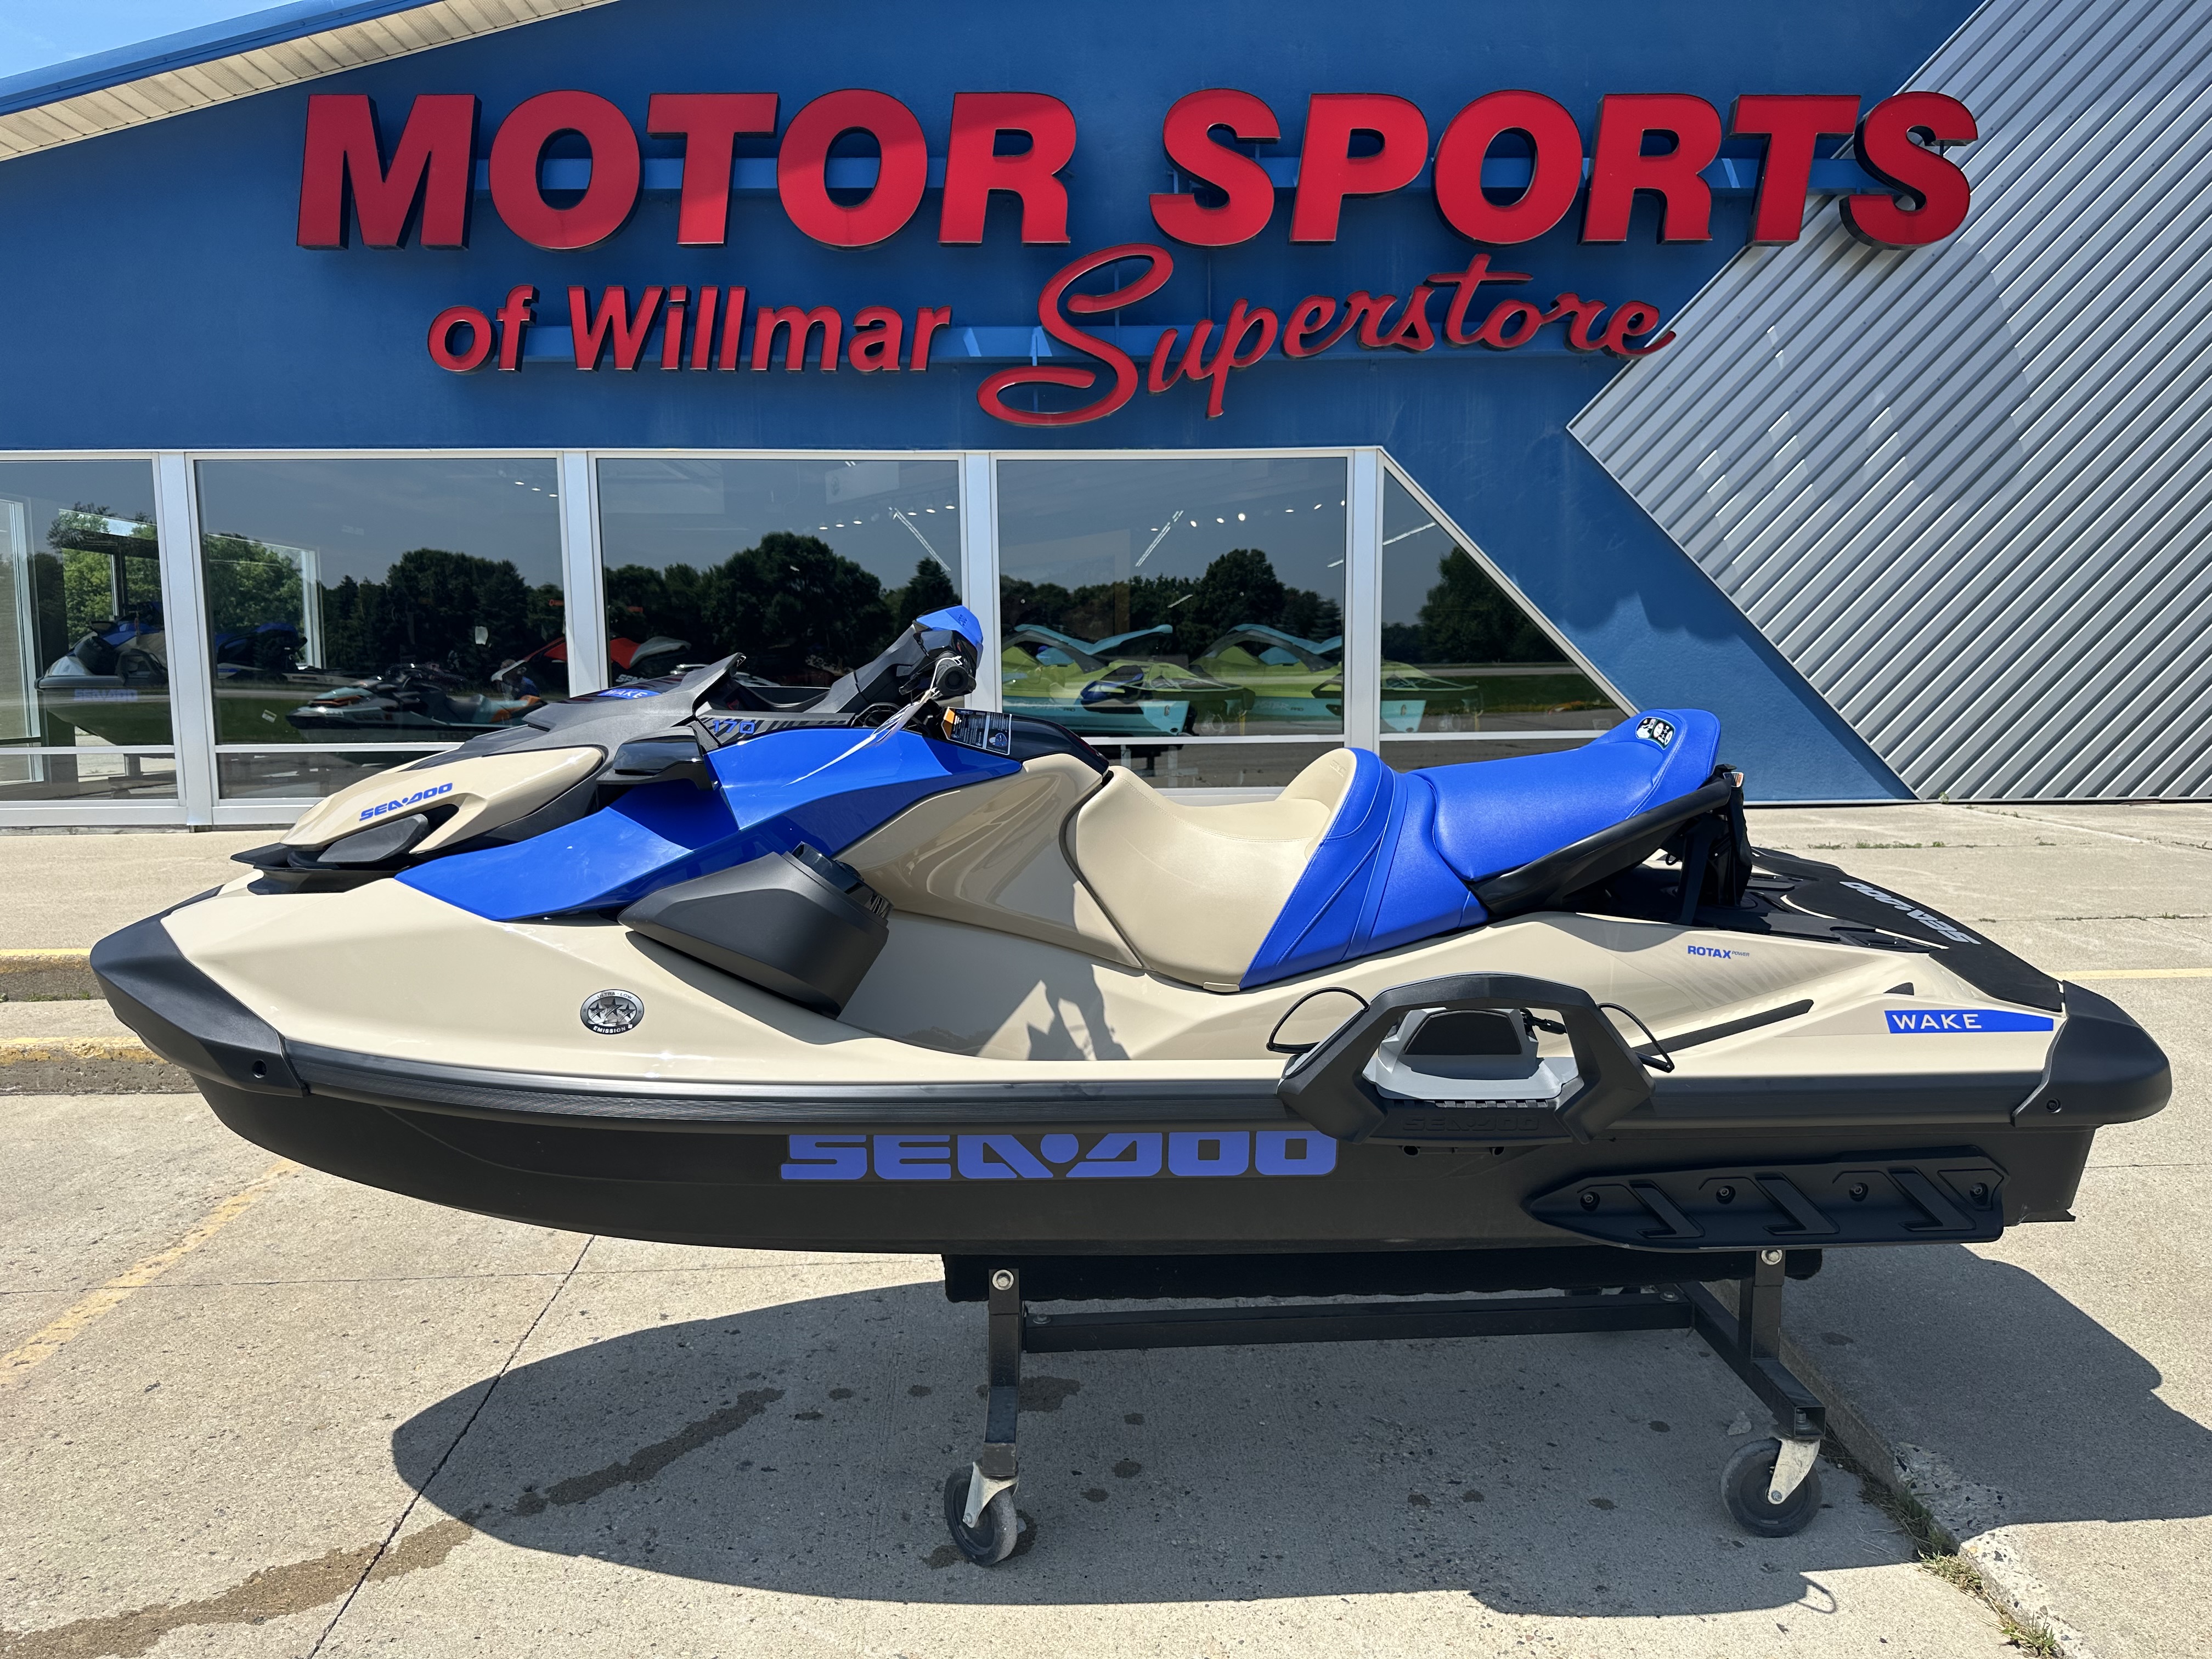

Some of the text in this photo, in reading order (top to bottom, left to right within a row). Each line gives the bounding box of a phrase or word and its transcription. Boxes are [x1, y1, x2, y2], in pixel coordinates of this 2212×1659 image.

[297, 88, 1978, 250] MOTOR SPORTS
[427, 244, 1677, 426] of Willmar Superstore
[605, 690, 647, 698] WAKE
[713, 720, 755, 733] 170
[1688, 945, 1731, 959] ROTAX
[1892, 1014, 1982, 1030] WAKE
[593, 1025, 626, 1034] EMISSION
